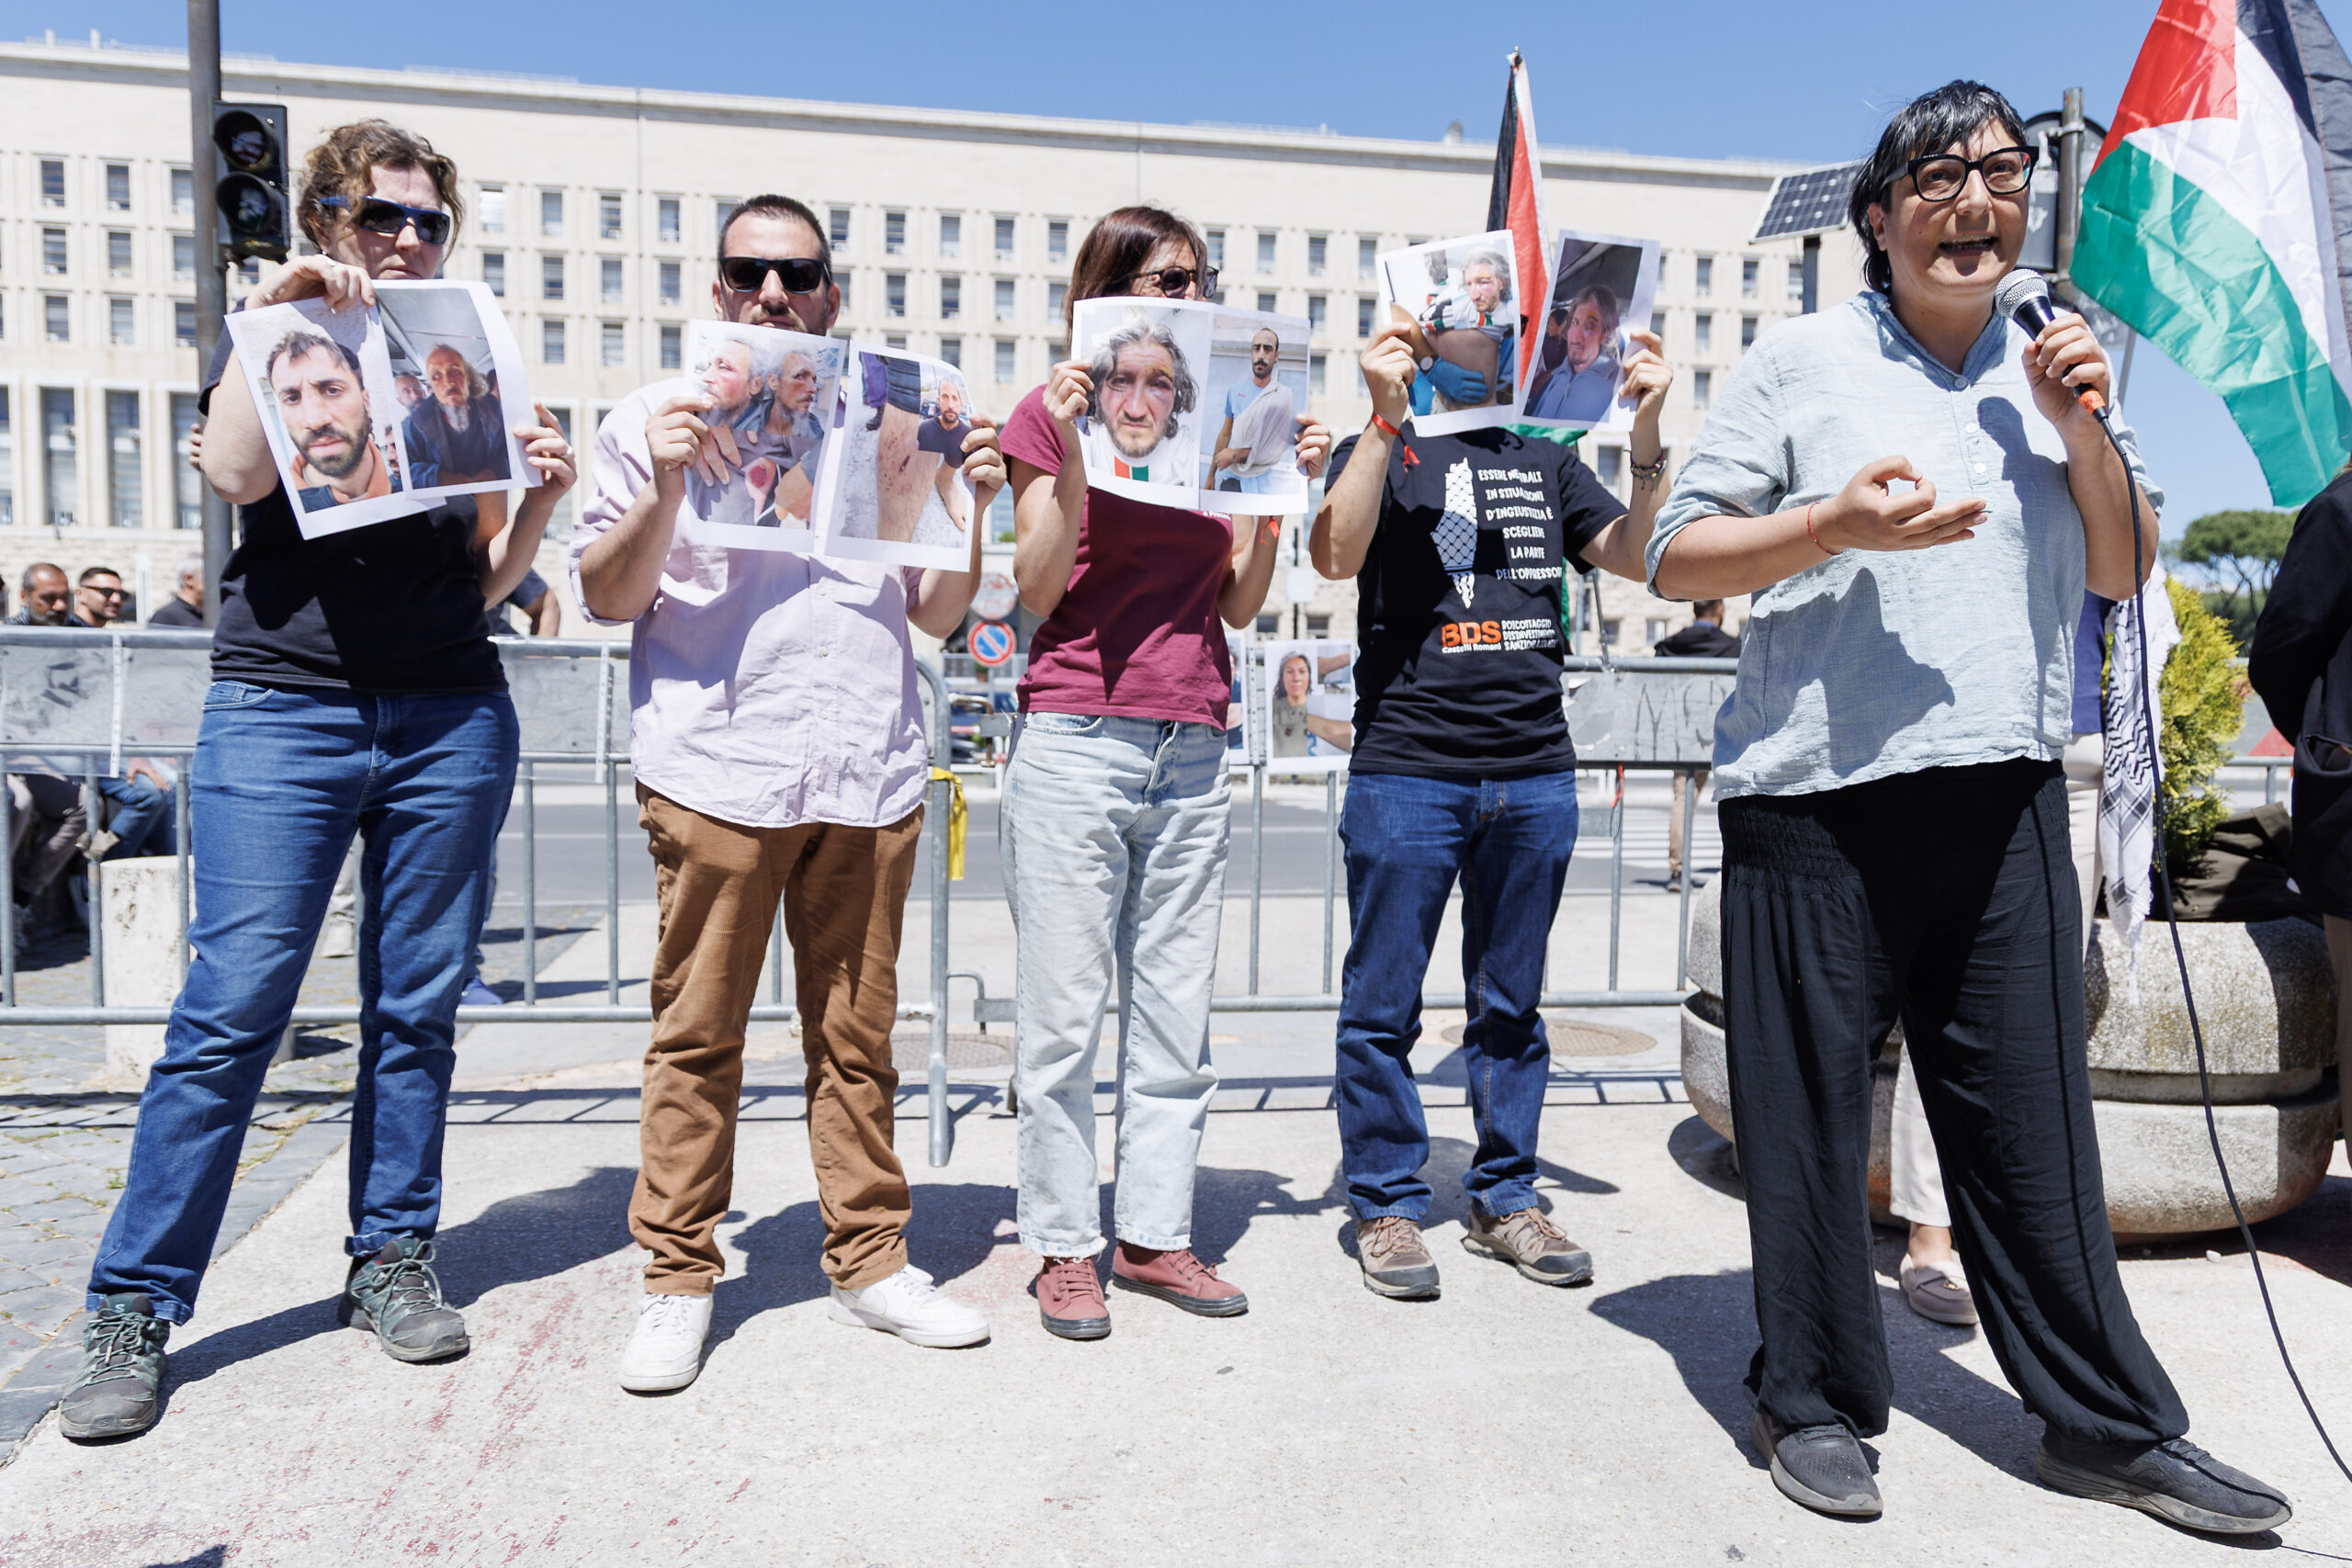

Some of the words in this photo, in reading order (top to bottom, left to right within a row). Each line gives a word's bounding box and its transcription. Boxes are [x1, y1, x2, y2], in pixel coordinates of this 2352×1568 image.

[1477, 469, 1508, 481] ESSERE
[1485, 489, 1498, 501] IN
[1510, 547, 1523, 558] LA
[1523, 547, 1545, 558] PARTE
[1442, 620, 1502, 648] BDS
[1442, 643, 1472, 653] Castelli
[1473, 643, 1502, 651] Romani
